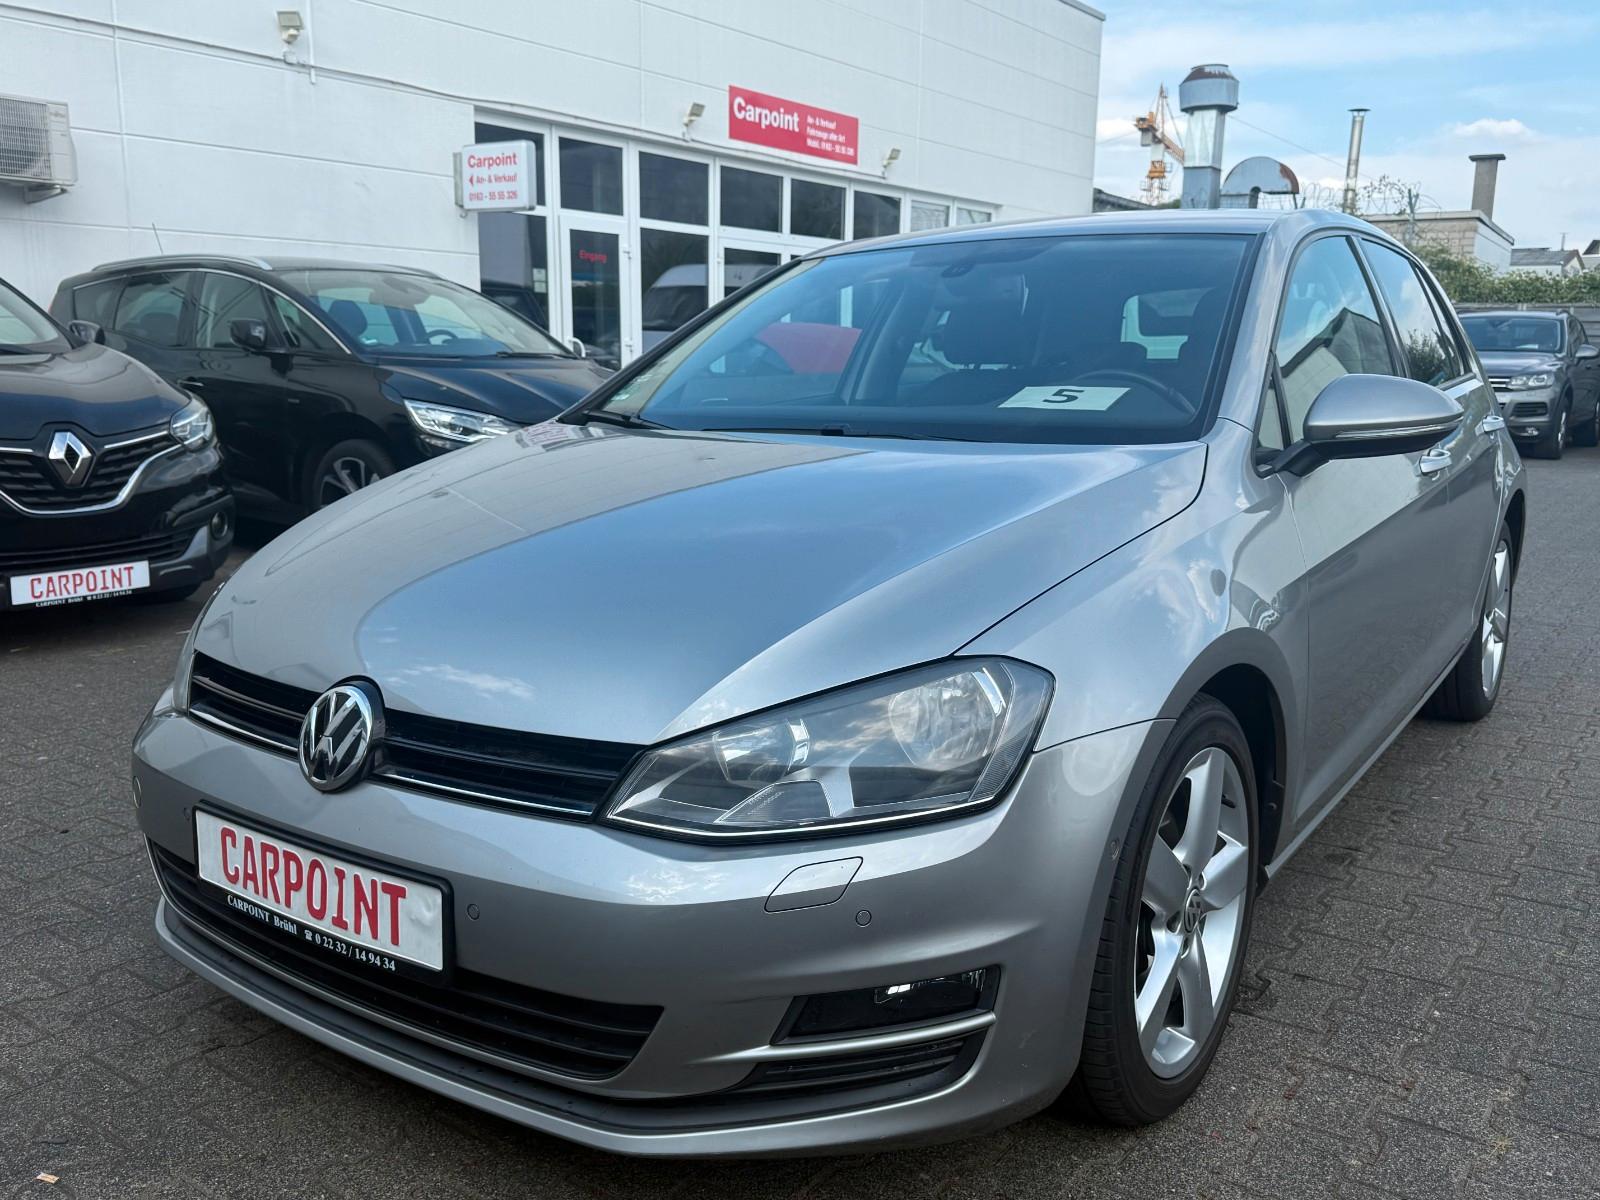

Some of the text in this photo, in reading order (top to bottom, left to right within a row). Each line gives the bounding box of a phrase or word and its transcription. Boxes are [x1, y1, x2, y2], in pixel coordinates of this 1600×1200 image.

[734, 96, 800, 132] Carpoint
[467, 152, 518, 169] Carpoint
[494, 173, 517, 183] Verkauf
[1042, 389, 1085, 404] 5
[30, 566, 134, 600] CARPOINT
[220, 826, 407, 946] CARPOINT
[227, 894, 270, 923] CARPOINT
[273, 915, 298, 935] Brühl
[315, 934, 321, 944] 0
[322, 936, 334, 949] 22
[335, 941, 347, 955] 32
[355, 948, 367, 962] 14
[368, 954, 381, 967] 94
[383, 957, 396, 971] 34
